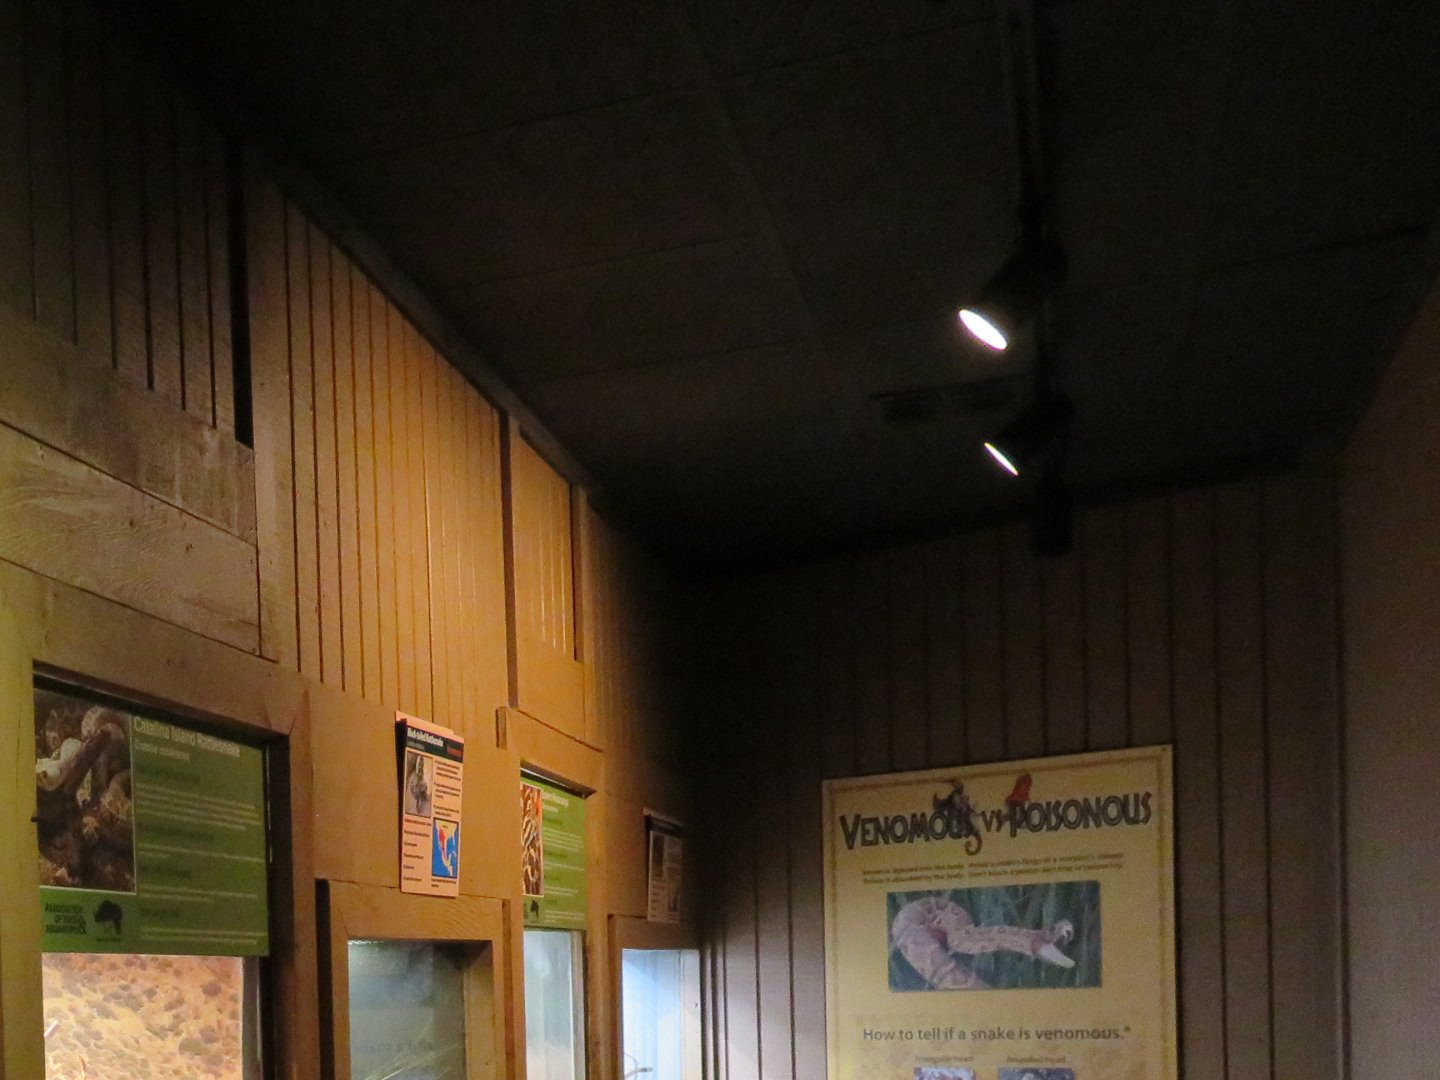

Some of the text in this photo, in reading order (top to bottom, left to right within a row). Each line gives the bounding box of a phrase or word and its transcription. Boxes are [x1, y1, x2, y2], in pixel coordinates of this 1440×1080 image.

[133, 715, 169, 739] Catalina
[170, 726, 195, 746] Island
[838, 811, 976, 851] VENOMOU
[1008, 791, 1153, 838] POISONOUS
[863, 1028, 894, 1040] How
[899, 1028, 913, 1040] to
[917, 1026, 940, 1040] tell
[944, 1026, 954, 1040] if
[958, 1029, 965, 1040] a
[969, 1026, 1014, 1040] snake
[1019, 1027, 1030, 1039] is
